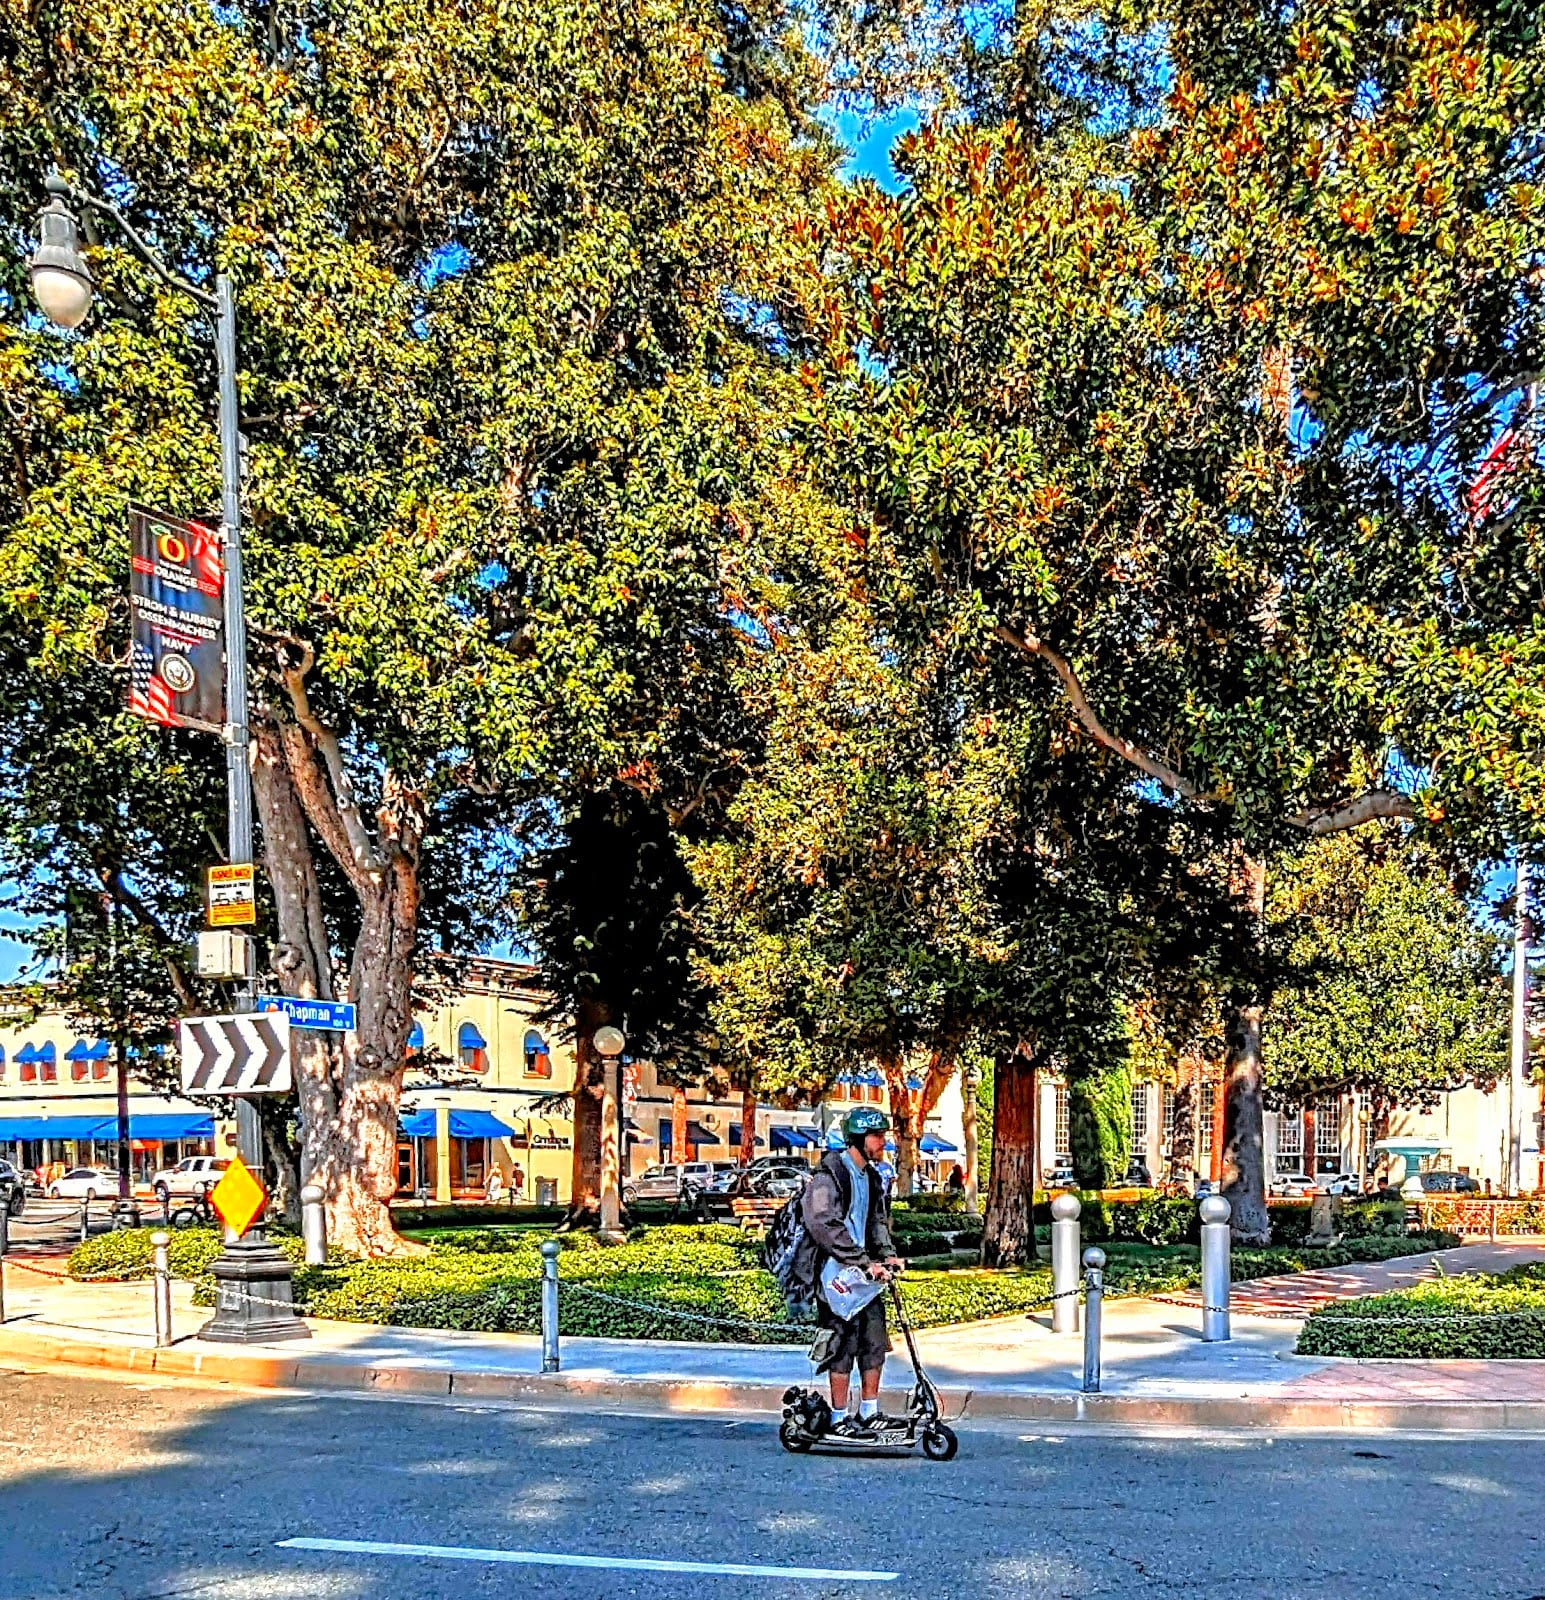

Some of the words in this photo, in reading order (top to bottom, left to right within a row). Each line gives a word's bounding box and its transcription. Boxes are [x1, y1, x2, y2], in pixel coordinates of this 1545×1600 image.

[153, 565, 198, 589] ORANGE
[131, 594, 168, 615] STROM
[168, 606, 178, 618] &
[179, 610, 222, 630] AUBREY
[138, 608, 217, 641] OSSENMACHER
[161, 635, 193, 654] NAVY
[282, 1001, 331, 1023] Chapman
